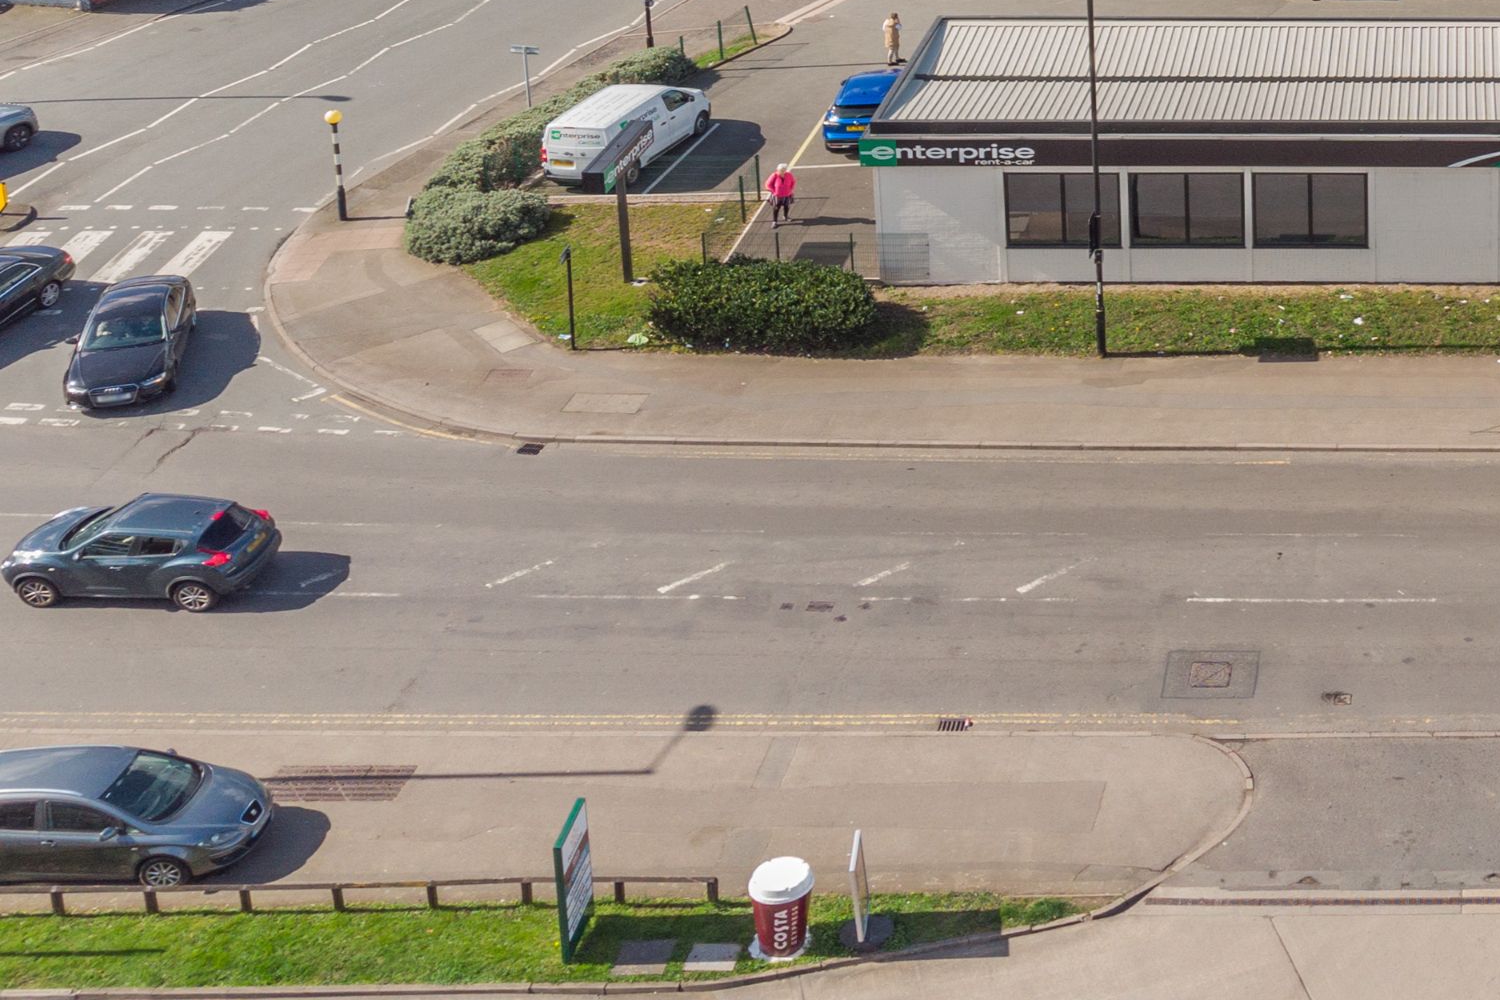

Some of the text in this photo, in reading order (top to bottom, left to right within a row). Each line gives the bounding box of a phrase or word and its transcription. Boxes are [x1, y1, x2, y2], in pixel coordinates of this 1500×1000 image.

[603, 129, 653, 184] enterprise
[862, 143, 1036, 163] enterprise
[773, 909, 790, 950] COSTA
